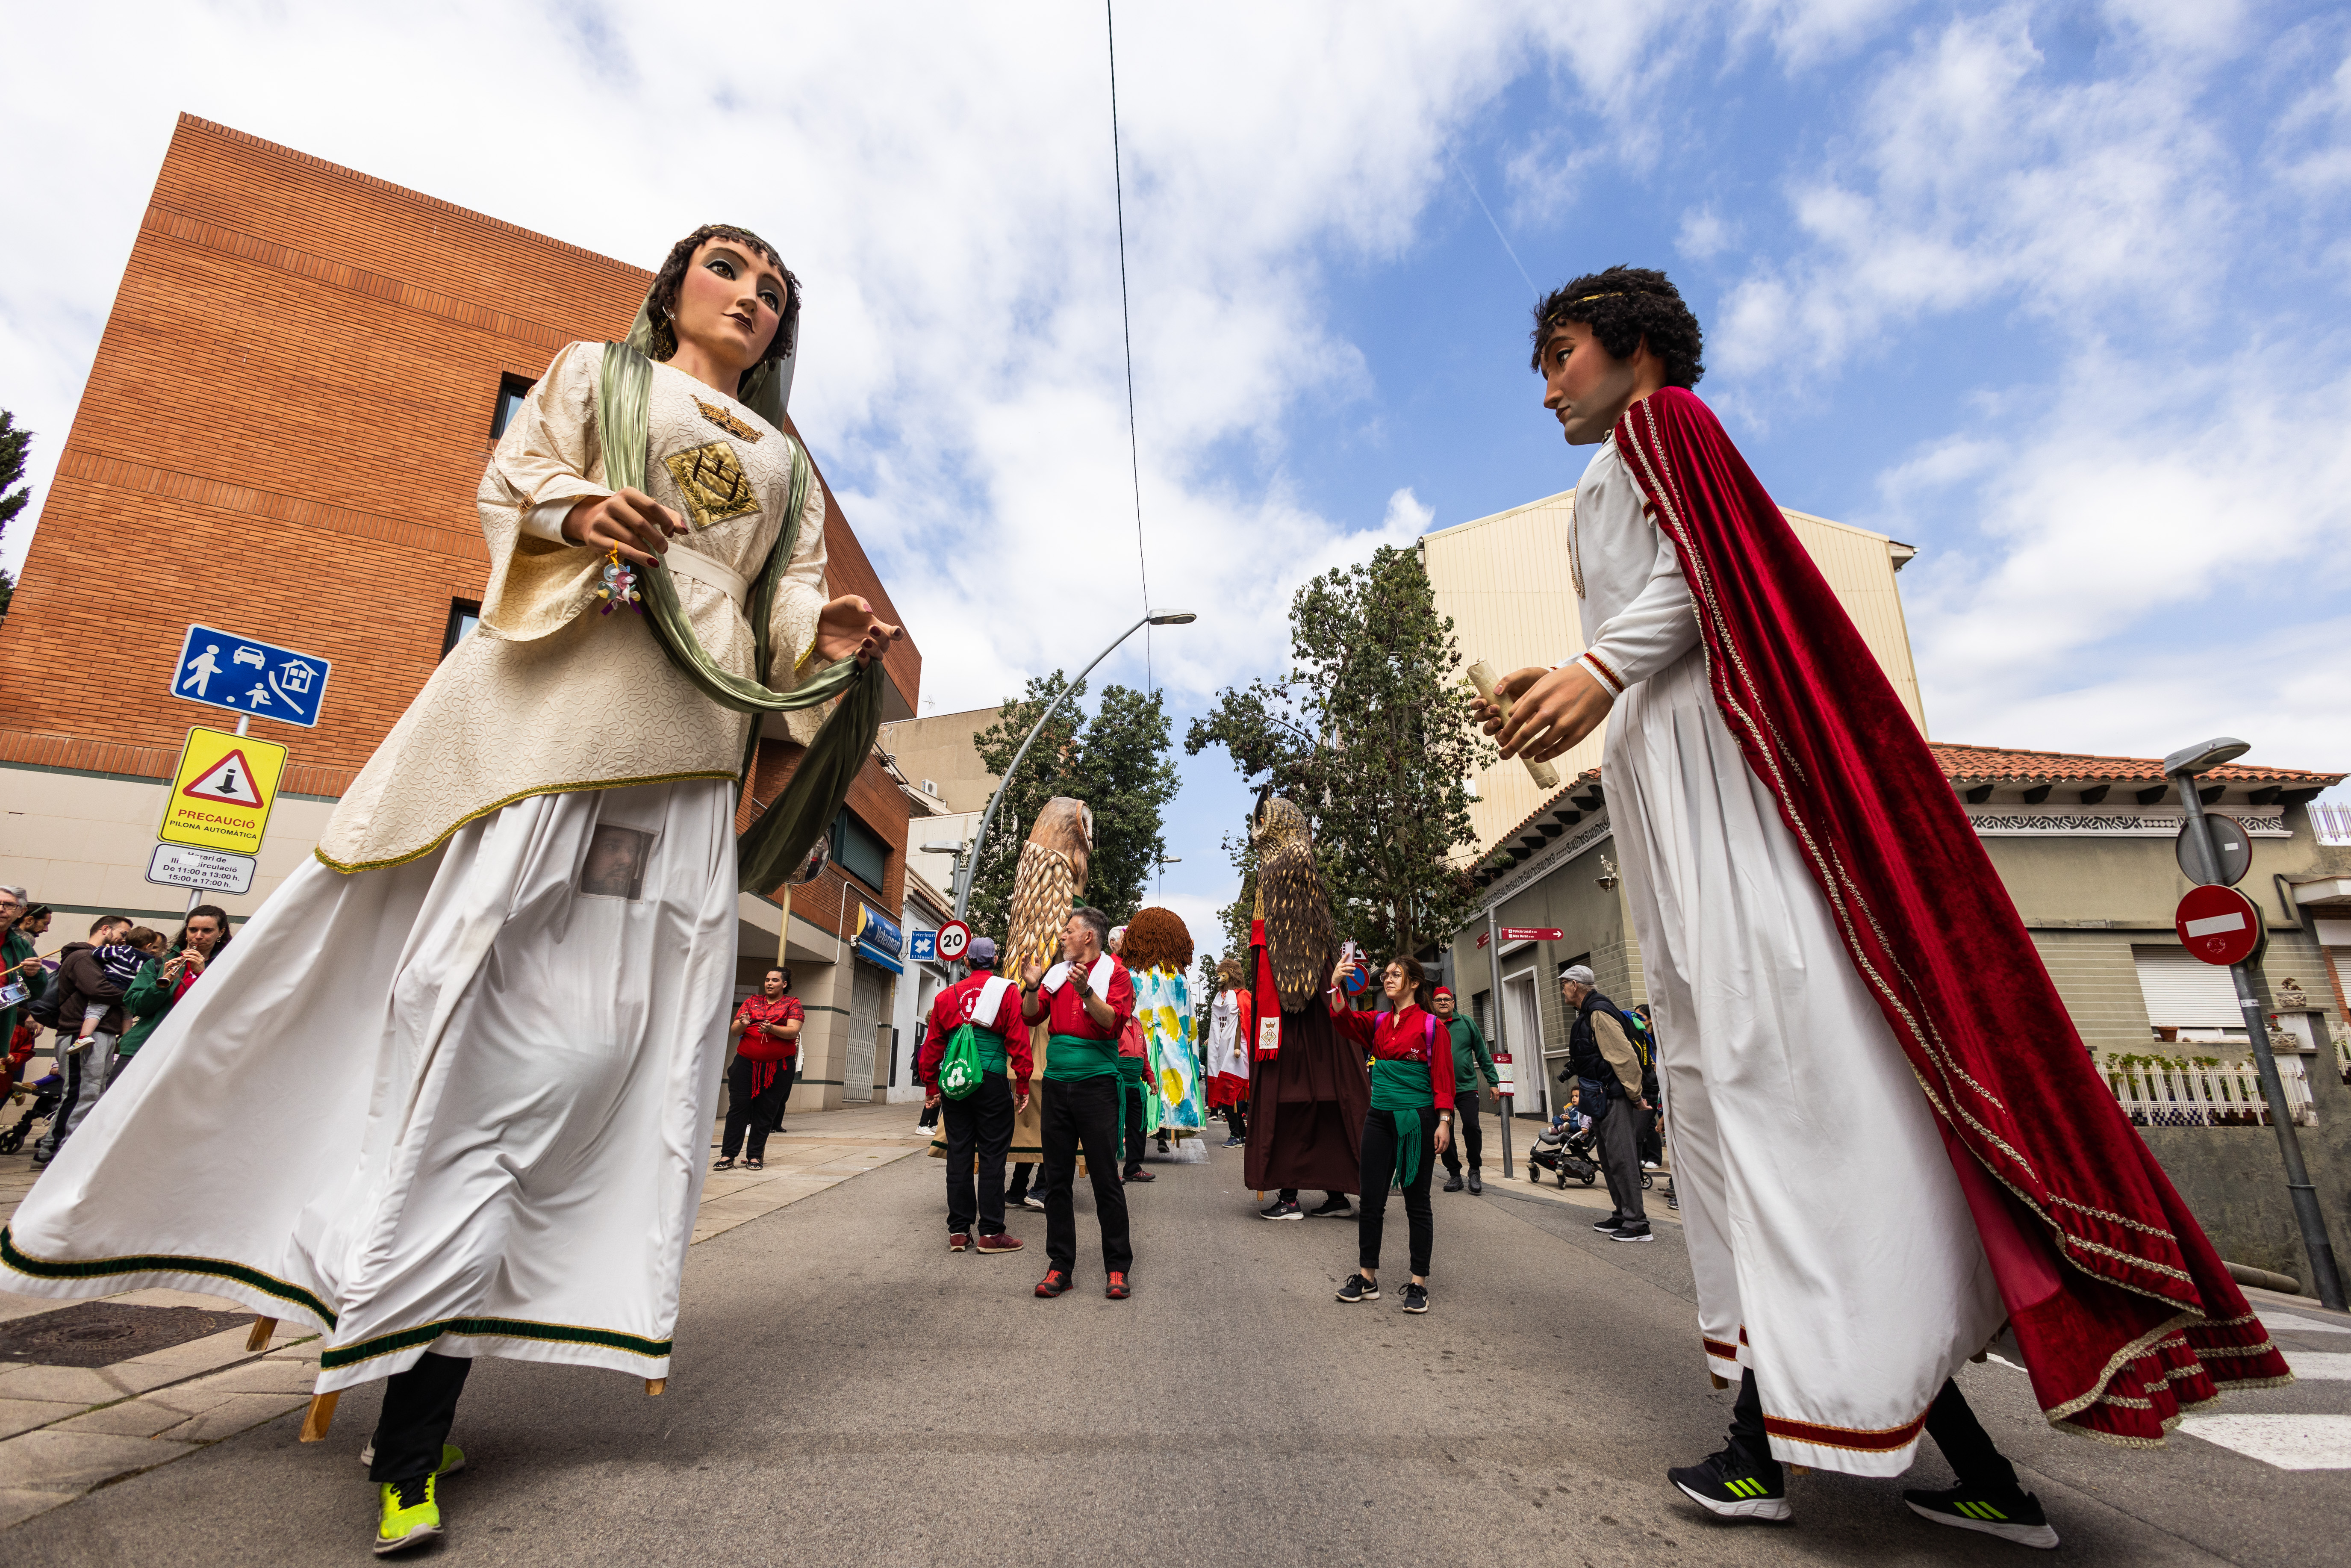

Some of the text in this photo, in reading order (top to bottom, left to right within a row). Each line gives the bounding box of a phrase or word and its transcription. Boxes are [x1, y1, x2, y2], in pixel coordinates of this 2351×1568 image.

[178, 809, 255, 829] PRECAUCIÓ
[169, 820, 256, 839] PILONA AUTOMÀTICA
[188, 852, 215, 861] Hrari
[168, 874, 191, 882] 15:00
[200, 878, 222, 887] 17:00
[178, 867, 200, 875] 11:00
[210, 872, 231, 880] 13:00
[875, 925, 901, 953] Veterinari
[943, 934, 962, 948] 20
